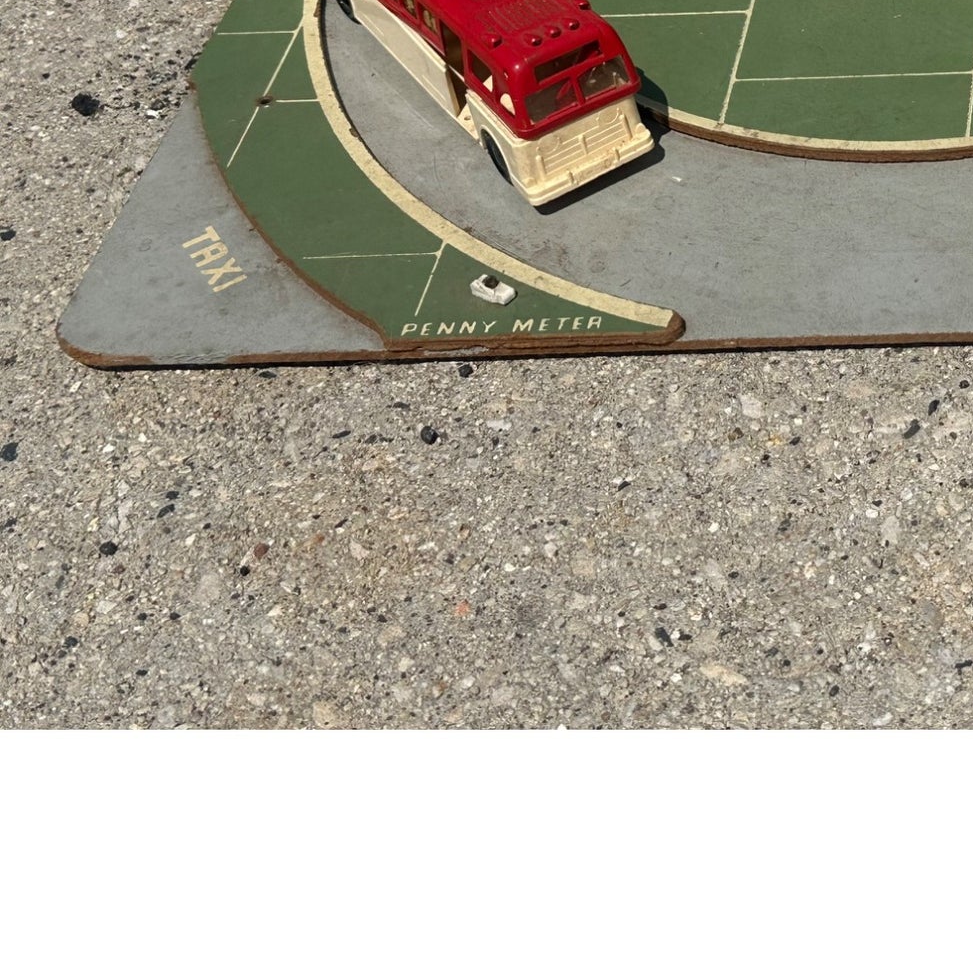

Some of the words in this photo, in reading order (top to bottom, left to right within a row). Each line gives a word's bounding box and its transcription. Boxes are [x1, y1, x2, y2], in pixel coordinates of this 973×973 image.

[181, 225, 247, 293] TAXI
[401, 321, 497, 337] PENNY
[512, 316, 603, 333] METER
